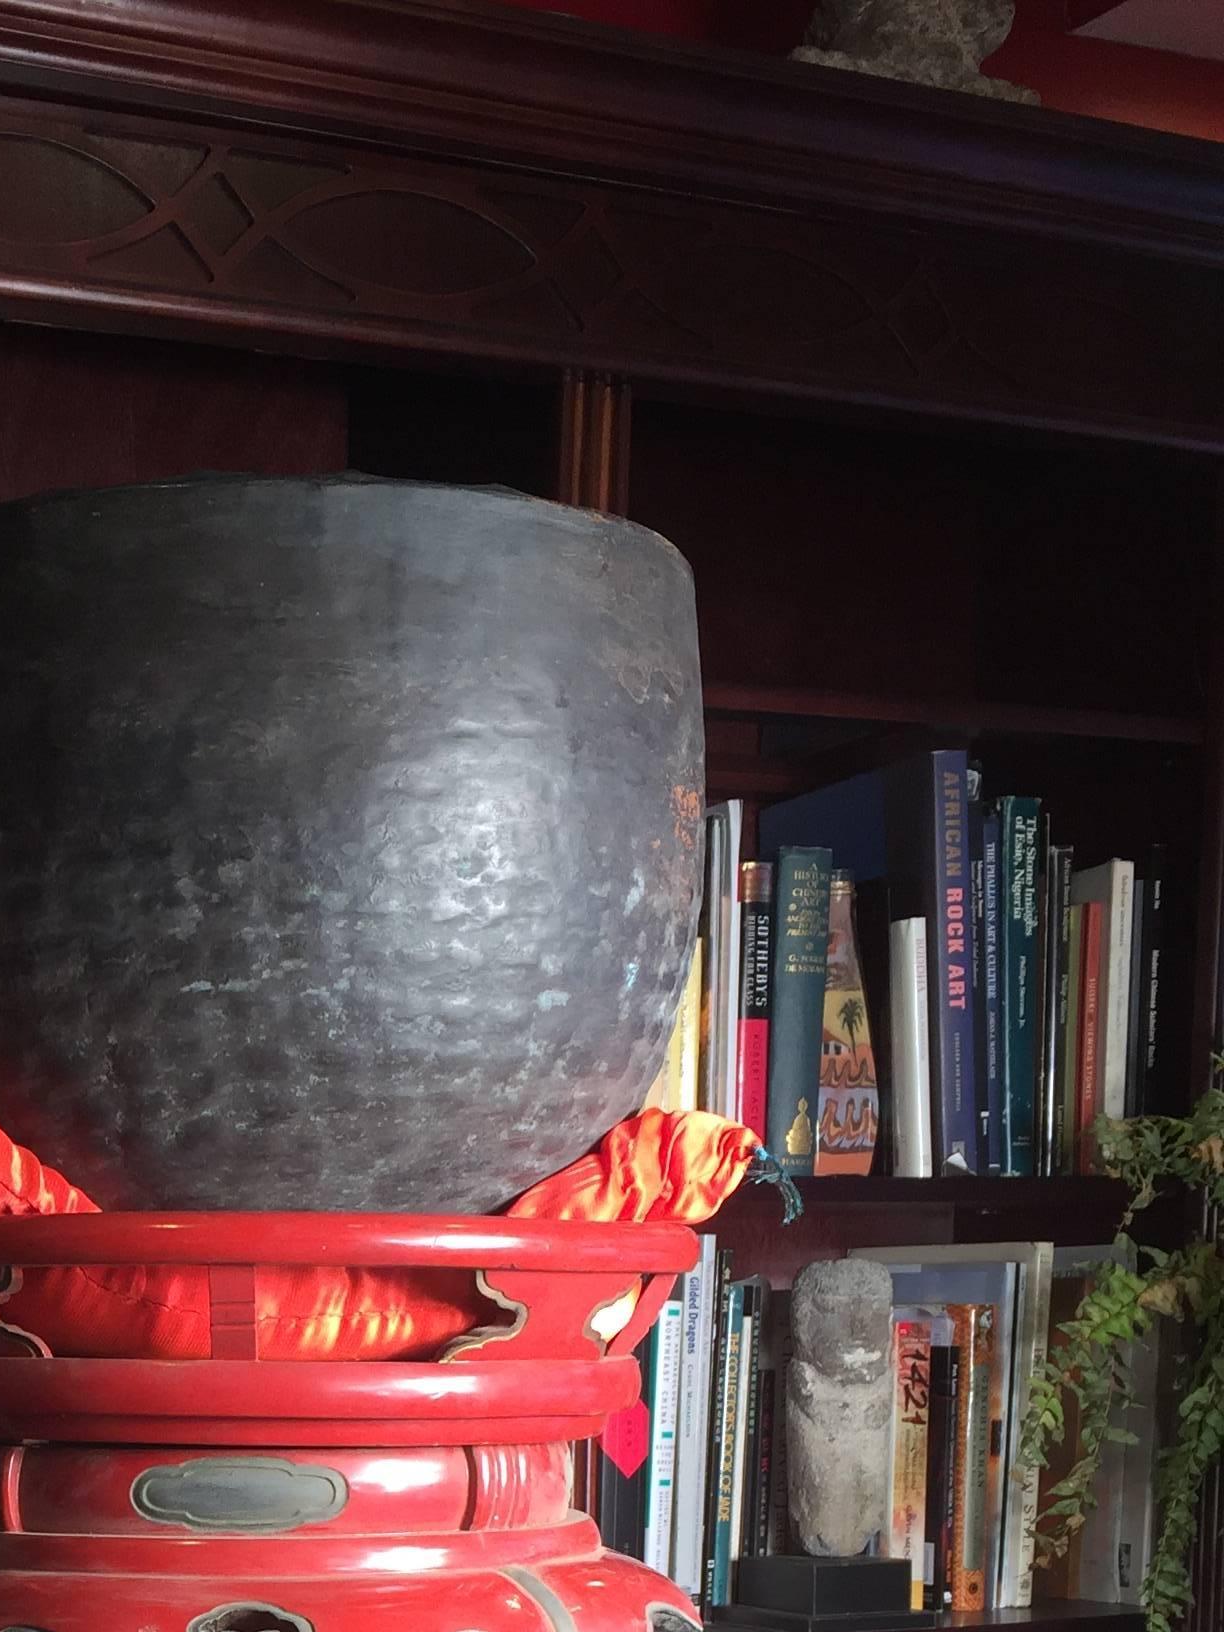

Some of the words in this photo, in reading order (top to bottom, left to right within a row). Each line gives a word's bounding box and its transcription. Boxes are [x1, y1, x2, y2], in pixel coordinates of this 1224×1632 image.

[944, 772, 962, 877] AFRICAN
[1015, 816, 1025, 831] of
[1027, 816, 1037, 845] The
[986, 843, 995, 864] THE
[1026, 847, 1036, 886] Stone
[986, 865, 995, 909] PHALLUS
[1012, 868, 1024, 920] Nigeria
[947, 888, 964, 954] ROCK
[1025, 888, 1036, 936] Images
[987, 925, 996, 944] ART
[756, 914, 770, 1008] SOTHEBY'S
[986, 955, 996, 1000] CULTURE
[948, 965, 966, 1010] ART
[688, 1276, 700, 1309] Gilded
[663, 1320, 672, 1383] NORTHEAST
[686, 1313, 699, 1355] Dragons
[729, 1333, 739, 1353] THE
[661, 1391, 669, 1424] CHINA
[724, 1354, 738, 1431] COLLECTOR'S
[901, 1348, 929, 1426] 1421
[722, 1433, 735, 1473] BOOK
[977, 1449, 985, 1488] KHAN
[721, 1475, 732, 1497] OF
[718, 1497, 731, 1521] JADE
